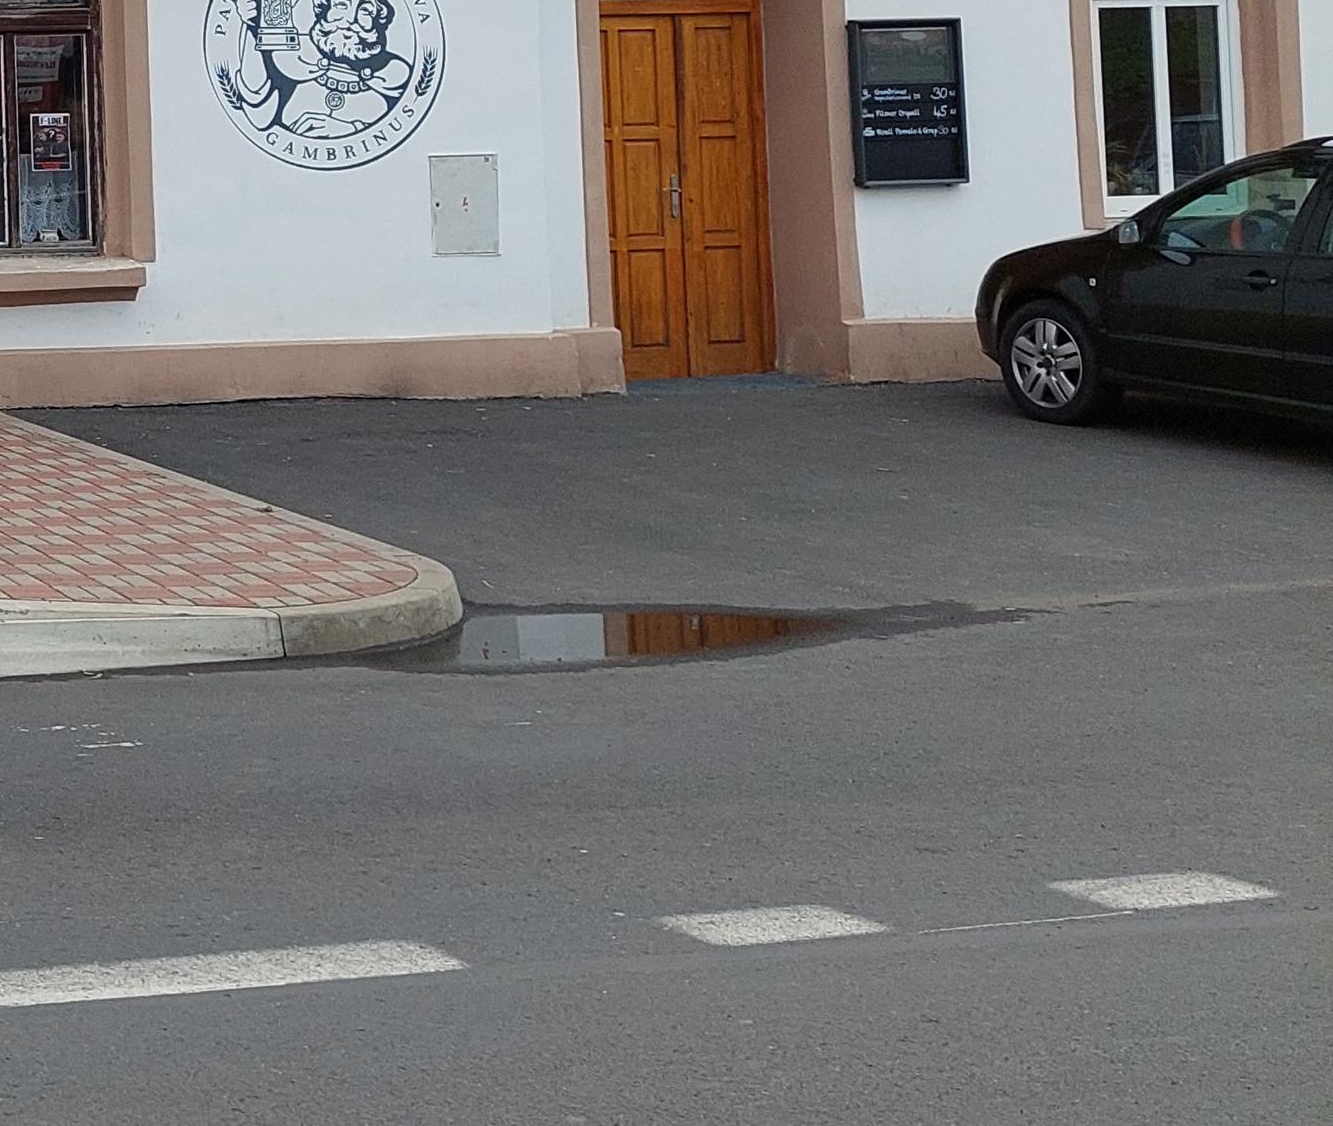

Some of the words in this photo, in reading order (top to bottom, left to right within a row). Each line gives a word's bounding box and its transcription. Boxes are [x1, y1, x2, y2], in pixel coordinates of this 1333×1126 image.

[930, 86, 948, 100] 30
[933, 104, 948, 118] 45
[266, 104, 415, 161] GAMBRINUS
